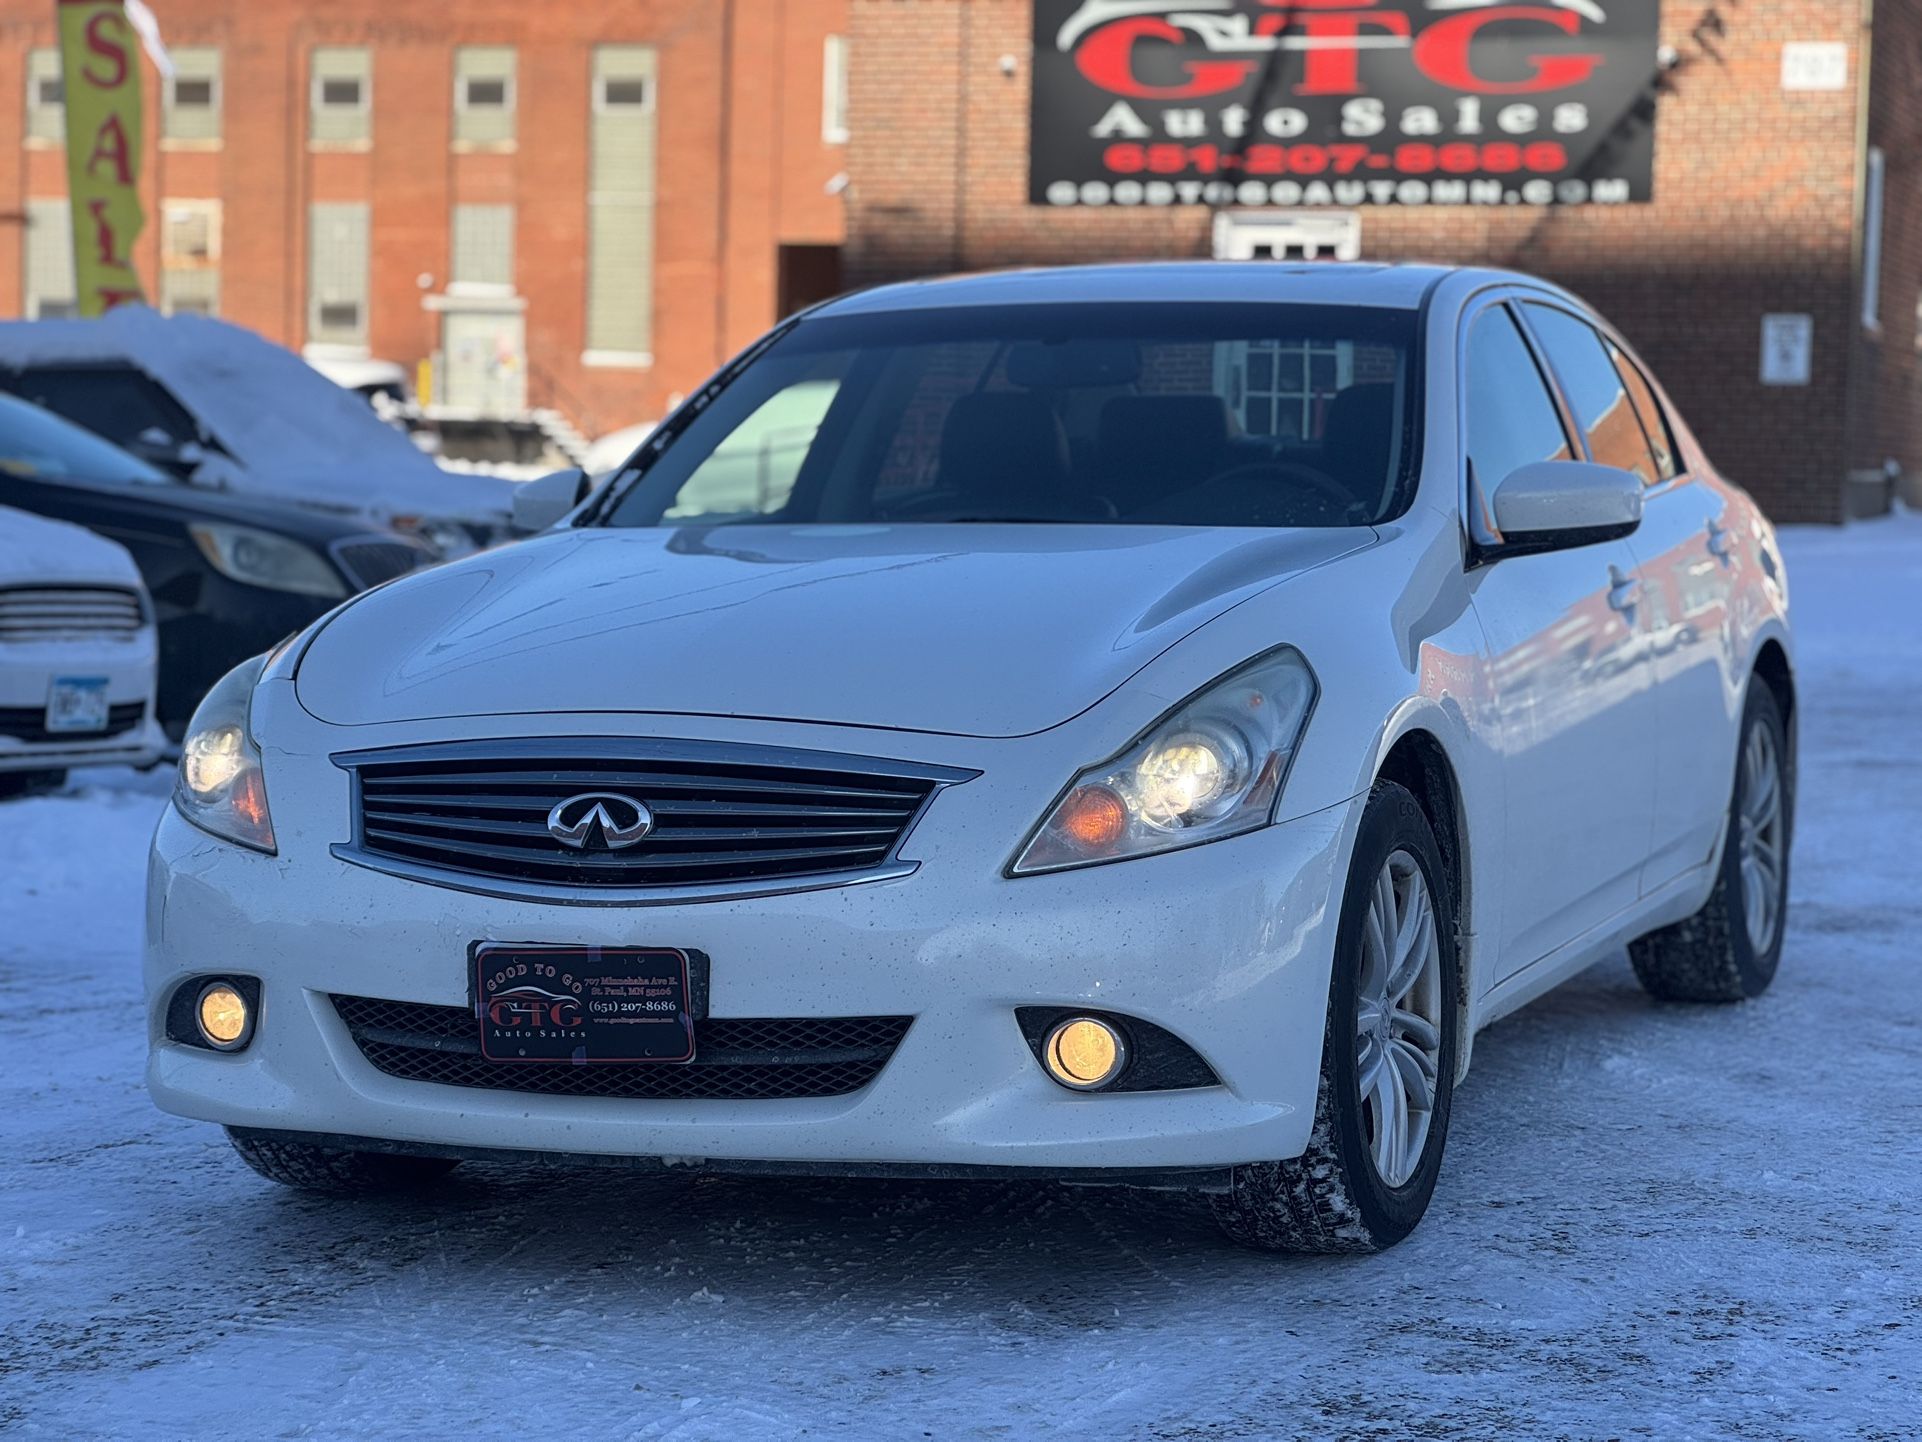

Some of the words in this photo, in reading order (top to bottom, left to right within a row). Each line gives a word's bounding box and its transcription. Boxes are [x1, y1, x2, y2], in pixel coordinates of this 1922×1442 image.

[1074, 5, 1605, 98] GTG
[1091, 100, 1308, 138] Auto
[1341, 97, 1588, 137] Sales
[1103, 142, 1567, 175] 651-207-8686
[486, 964, 527, 991] GOOD
[534, 963, 556, 978] TO
[562, 973, 583, 994] GO
[584, 978, 600, 987] 707
[650, 976, 667, 985] Ave
[591, 987, 603, 995] St.
[604, 987, 627, 997] Paul,
[628, 987, 645, 996] MN
[489, 1001, 584, 1027] GTG
[589, 1001, 618, 1013] (651)
[620, 1001, 676, 1013] 207-8686
[493, 1029, 531, 1038] Auto
[540, 1029, 586, 1038] Sales
